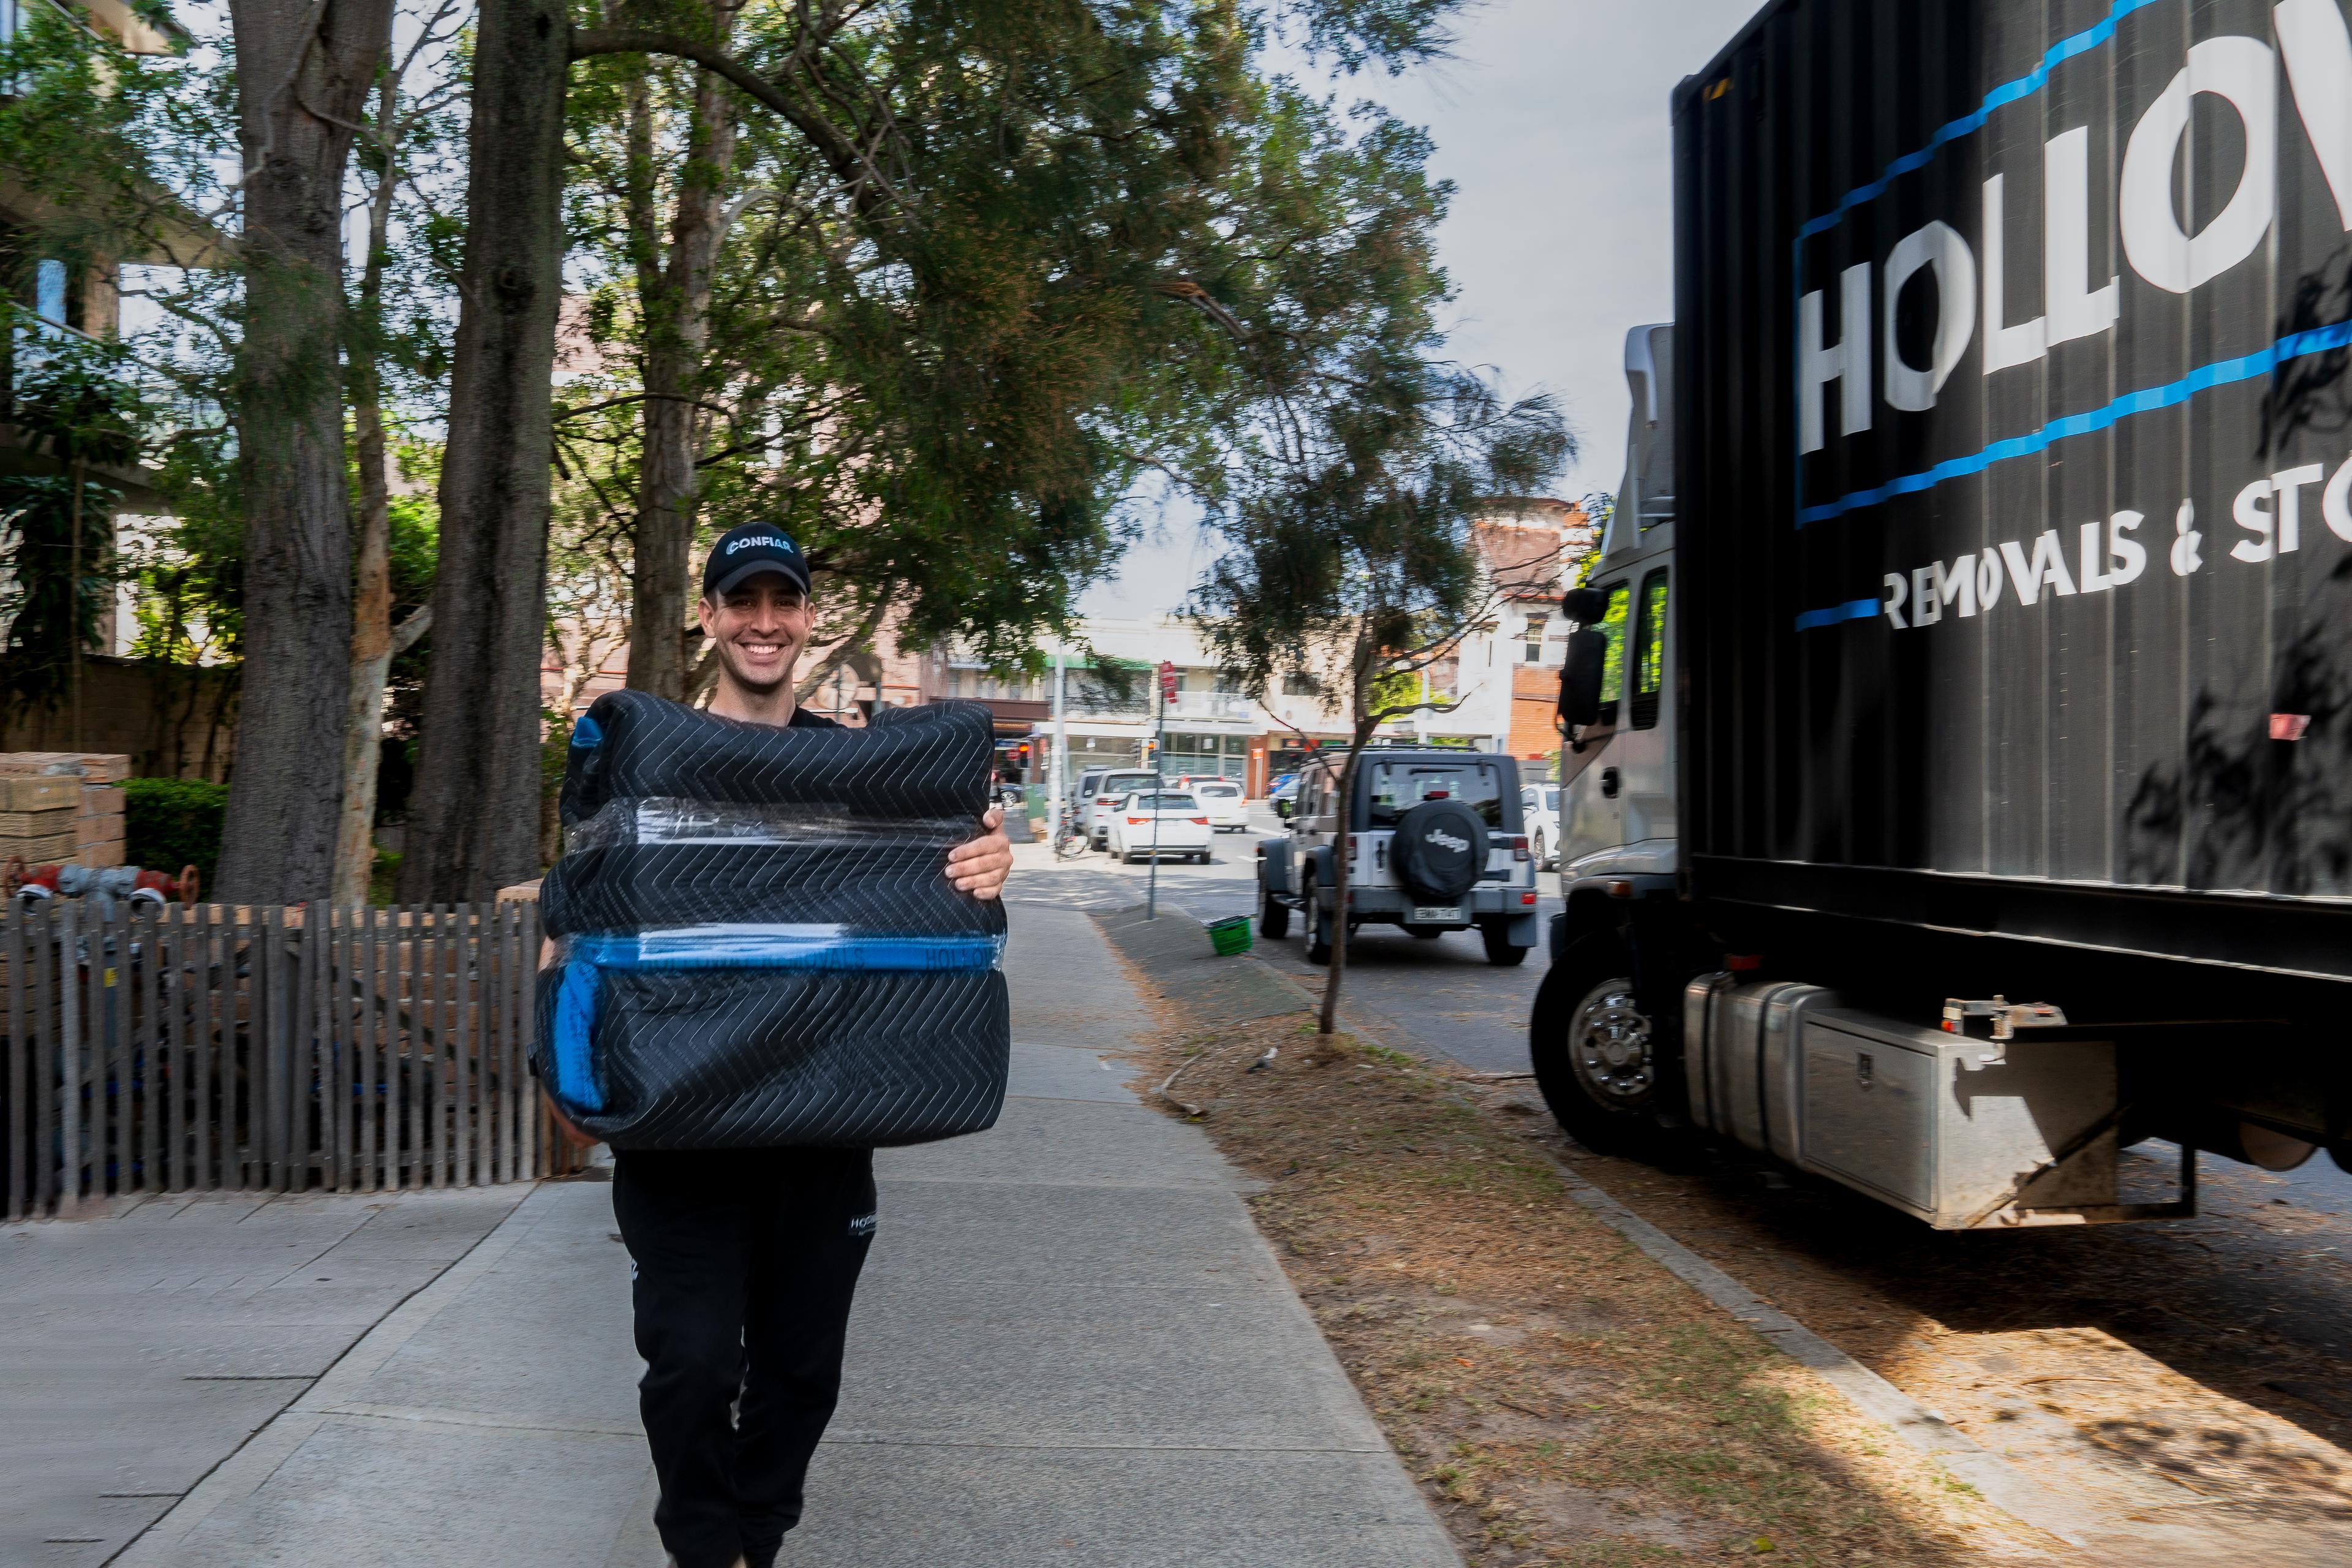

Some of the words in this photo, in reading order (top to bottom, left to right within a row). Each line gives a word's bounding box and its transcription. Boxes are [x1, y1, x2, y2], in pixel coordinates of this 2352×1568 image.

[726, 536, 794, 555] CONFIAR
[1884, 510, 2146, 630] REMOVALS
[2170, 497, 2203, 576] &
[1425, 829, 1470, 853] Jeep
